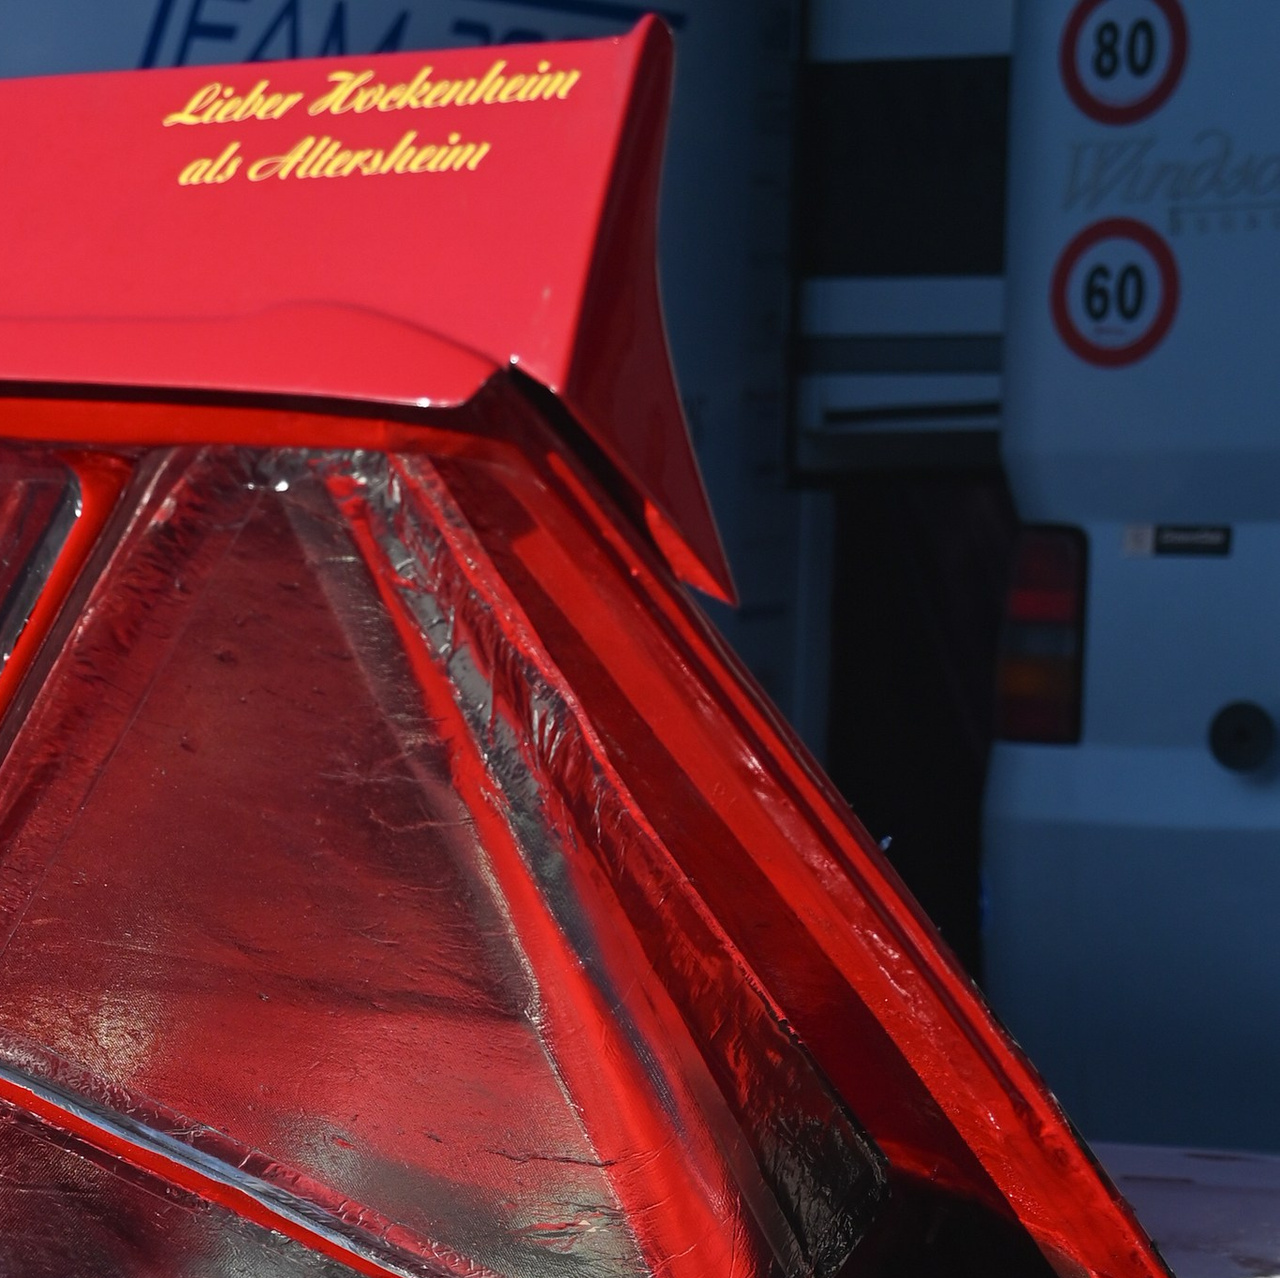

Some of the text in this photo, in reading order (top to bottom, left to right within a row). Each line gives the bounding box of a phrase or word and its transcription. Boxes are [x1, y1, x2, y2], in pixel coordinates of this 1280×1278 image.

[1093, 18, 1156, 80] 80
[162, 60, 581, 128] Lieber Hockenheim
[177, 130, 491, 186] als Altersheim
[1083, 264, 1146, 322] 60
